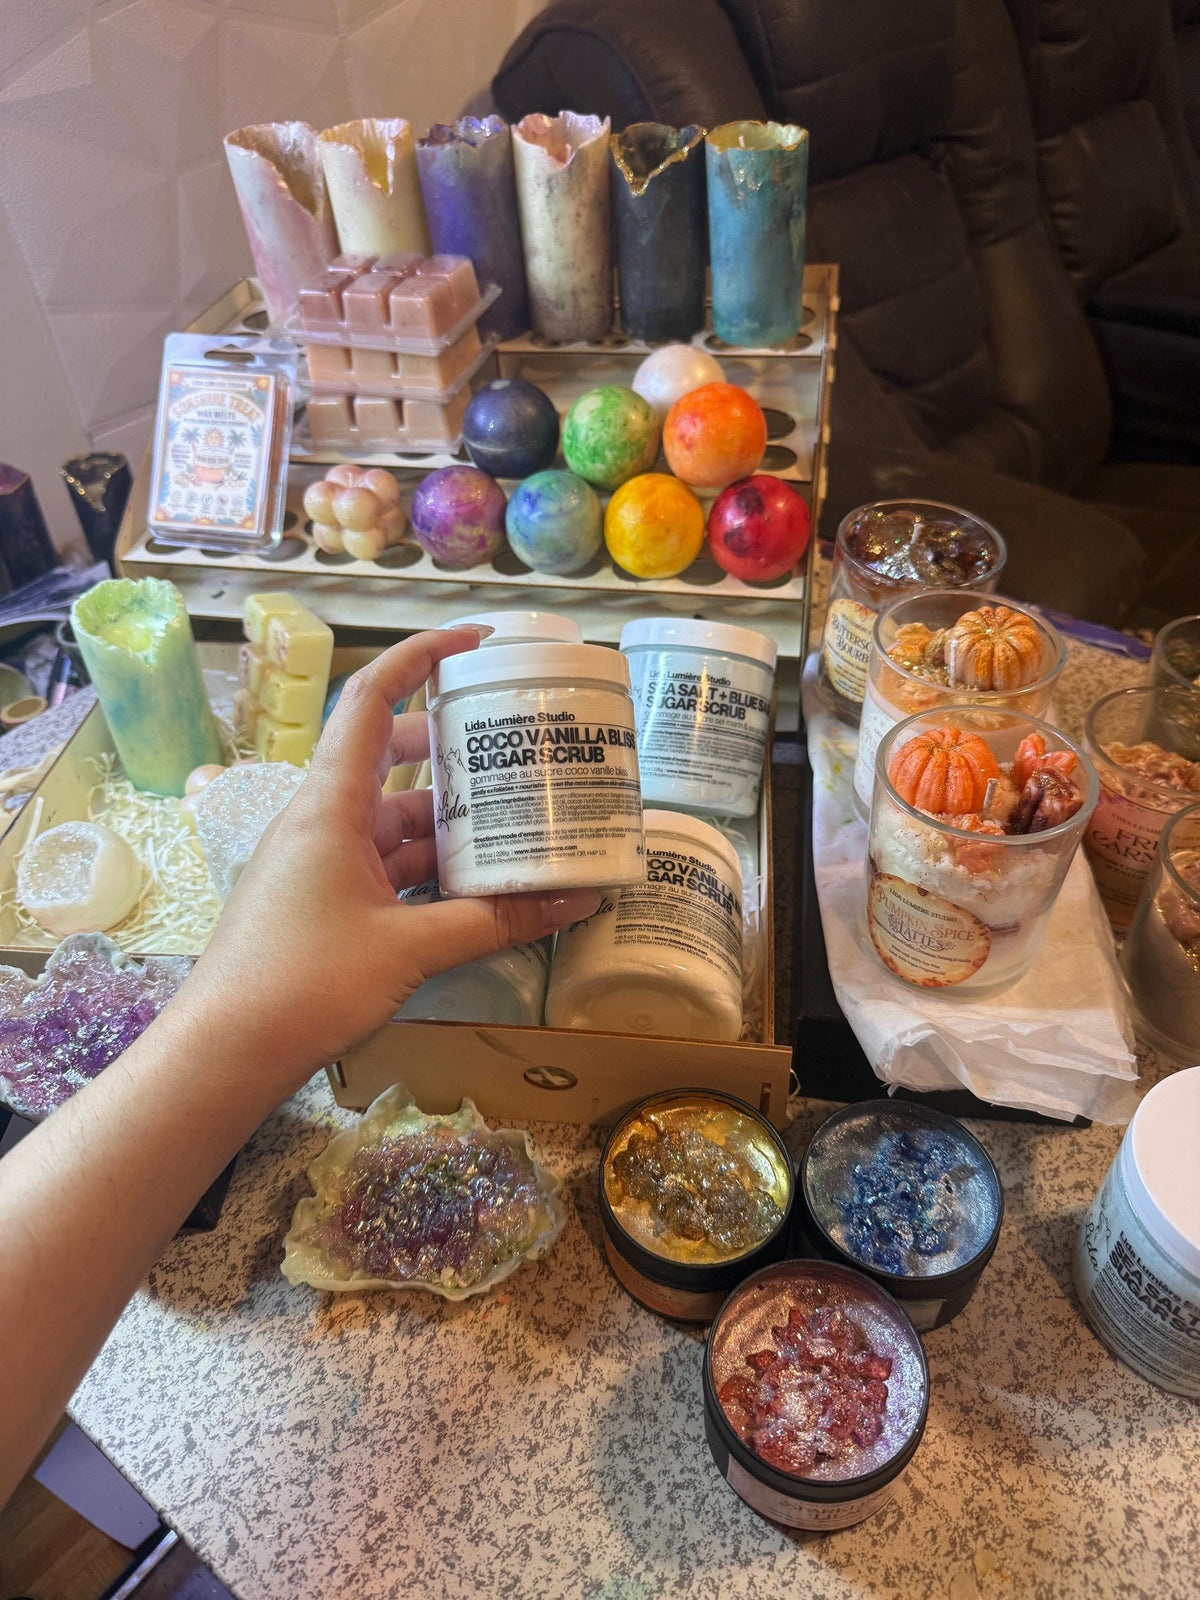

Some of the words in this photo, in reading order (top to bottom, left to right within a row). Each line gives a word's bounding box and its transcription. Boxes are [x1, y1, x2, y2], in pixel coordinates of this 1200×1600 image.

[667, 671, 702, 682] Lumière
[699, 699, 746, 721] SCRUB
[720, 692, 727, 701] +
[729, 691, 758, 711] BLUE
[464, 720, 486, 732] Lida
[488, 714, 536, 728] Lumière
[537, 711, 575, 722] Studio
[466, 730, 523, 754] COCO
[525, 727, 607, 746] VANILLA
[608, 729, 636, 750] BLISS
[468, 748, 537, 773] SUGAR
[539, 746, 605, 764] SCRUB
[470, 771, 518, 787] gommage
[519, 769, 532, 779] au
[534, 768, 563, 777] sucre
[565, 767, 589, 776] coco
[591, 765, 614, 775] vanille
[615, 767, 629, 777] bliss
[647, 849, 688, 861] Lumière
[688, 856, 717, 875] Studio
[678, 862, 734, 905] VANILLA
[686, 878, 733, 916] SCRUB
[876, 885, 929, 931] PUMPKIN
[930, 923, 977, 941] SPICE
[931, 912, 957, 923] STUDIO
[1114, 1240, 1145, 1287] SEA
[1120, 1230, 1136, 1258] Lida
[1137, 1256, 1182, 1302] Lumière
[1109, 1250, 1169, 1322] SUGAR
